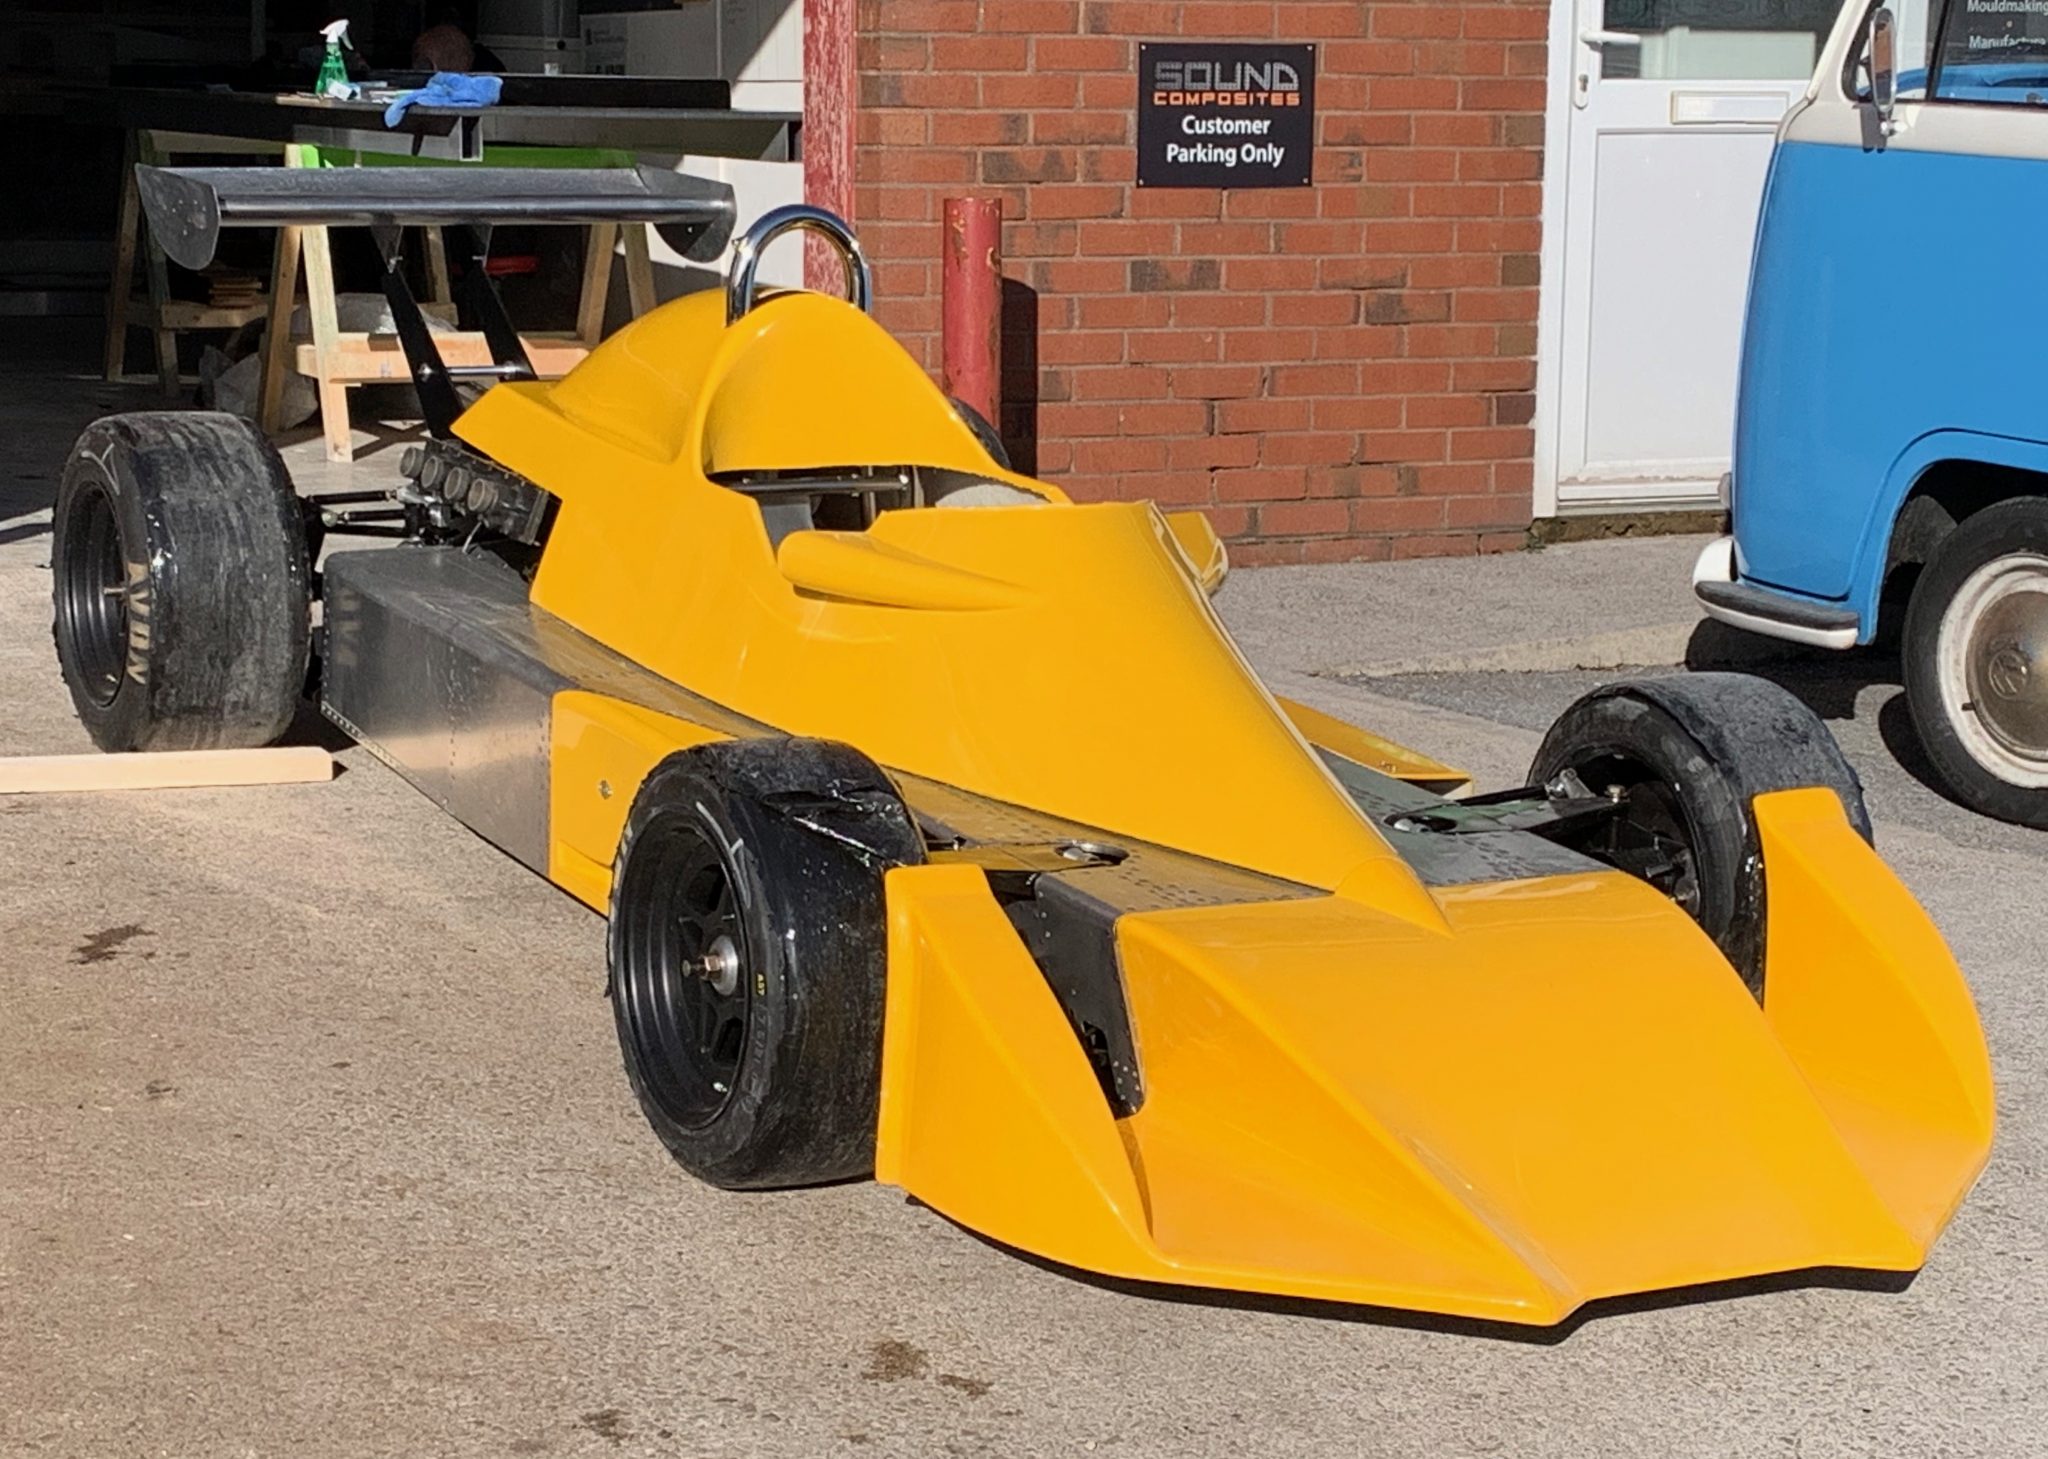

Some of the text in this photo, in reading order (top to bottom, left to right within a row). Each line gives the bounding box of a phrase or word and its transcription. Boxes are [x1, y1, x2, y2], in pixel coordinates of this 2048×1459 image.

[1967, 0, 2048, 15] Mouldmaking
[1155, 61, 1299, 91] SOUND
[1153, 92, 1300, 106] COMPOSITES
[1181, 115, 1271, 135] Customer
[1166, 143, 1285, 168] Parking Only
[127, 561, 151, 685] AVON
